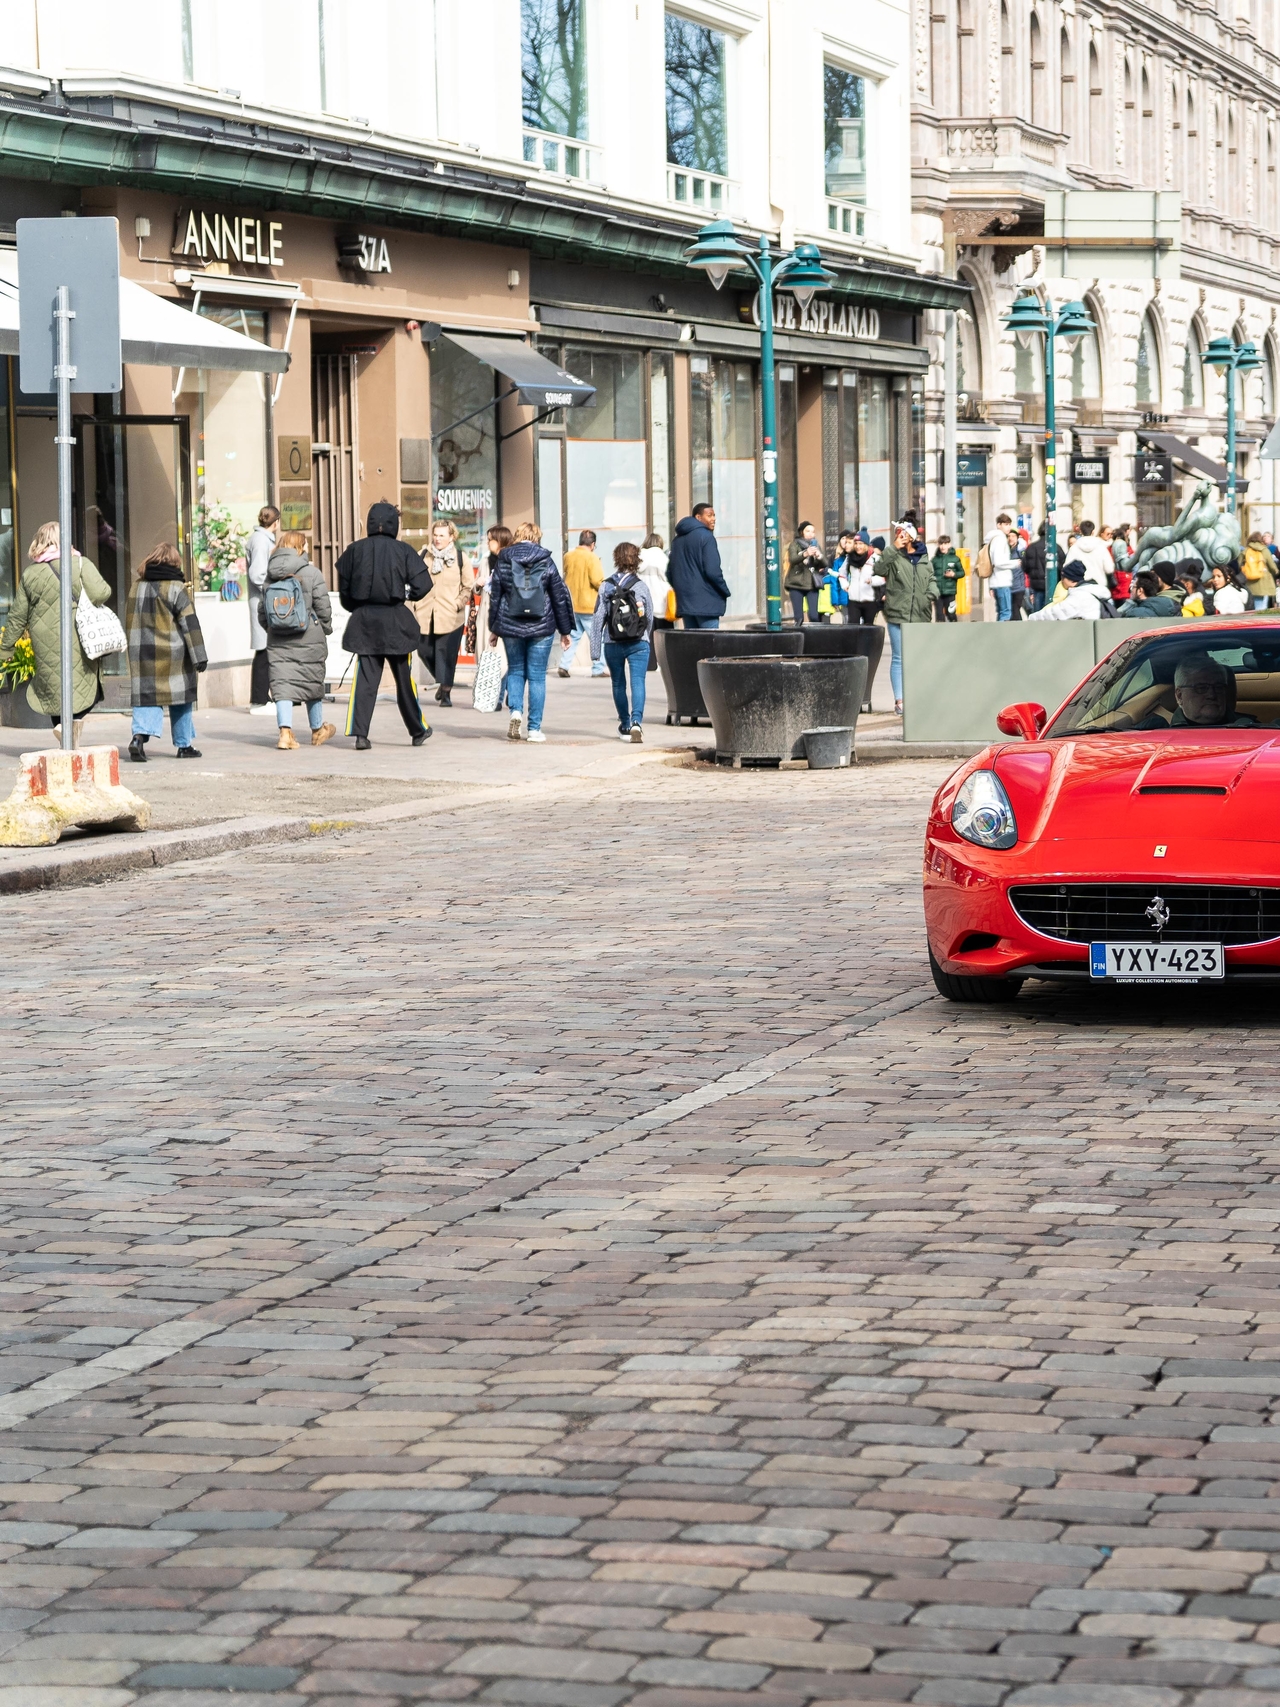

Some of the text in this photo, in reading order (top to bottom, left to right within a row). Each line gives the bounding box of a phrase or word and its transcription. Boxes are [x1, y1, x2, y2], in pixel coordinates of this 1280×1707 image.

[183, 209, 284, 267] ANNELE
[358, 234, 392, 274] 37A
[799, 298, 881, 341] ESPLANAD
[437, 488, 492, 511] SOUVENIRS
[1093, 948, 1217, 972] FIN YXY-423
